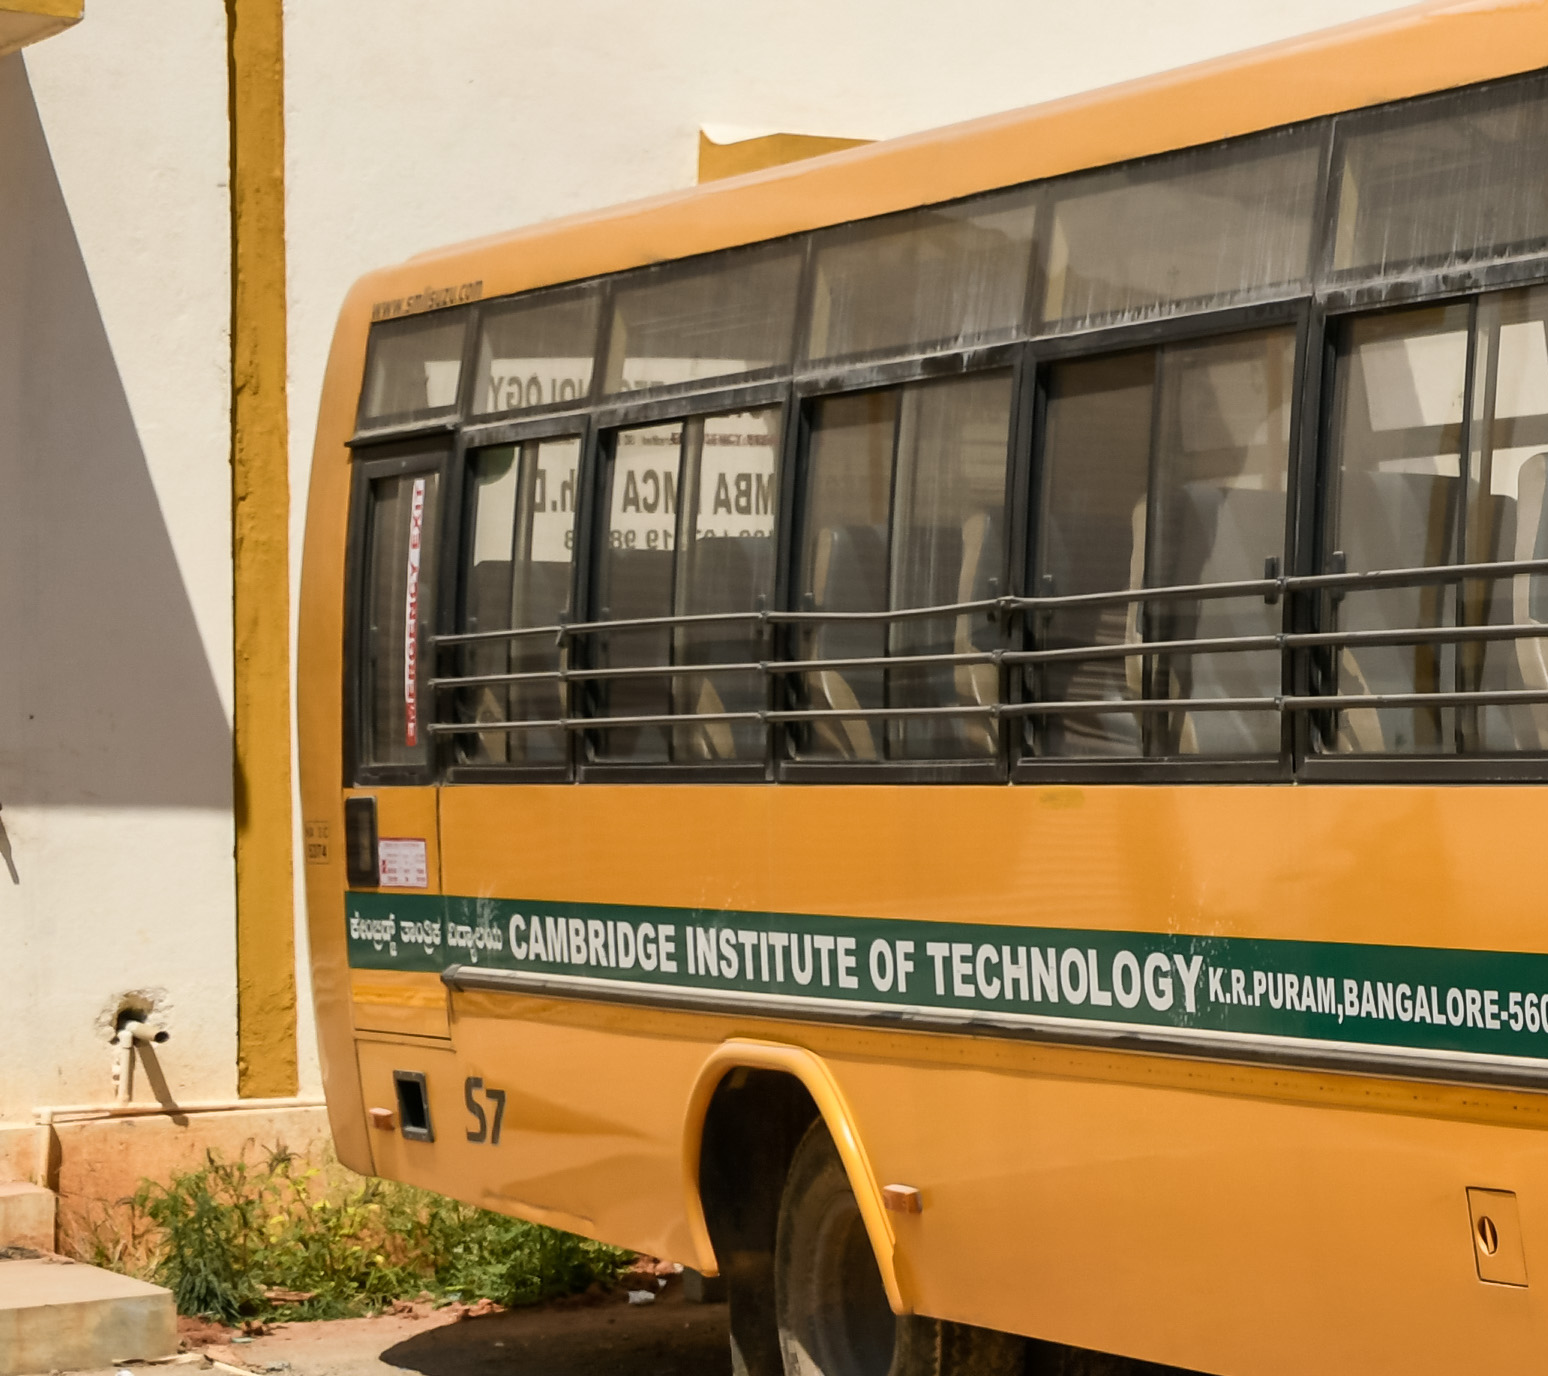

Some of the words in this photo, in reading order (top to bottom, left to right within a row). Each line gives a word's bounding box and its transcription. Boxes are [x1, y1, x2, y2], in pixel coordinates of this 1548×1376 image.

[509, 914, 677, 974] CAMBRIDGE
[686, 925, 859, 989] INSTITUTE
[869, 938, 916, 993] OF
[927, 941, 1204, 1013] TECHNOLOGY
[464, 1075, 506, 1145] S7
